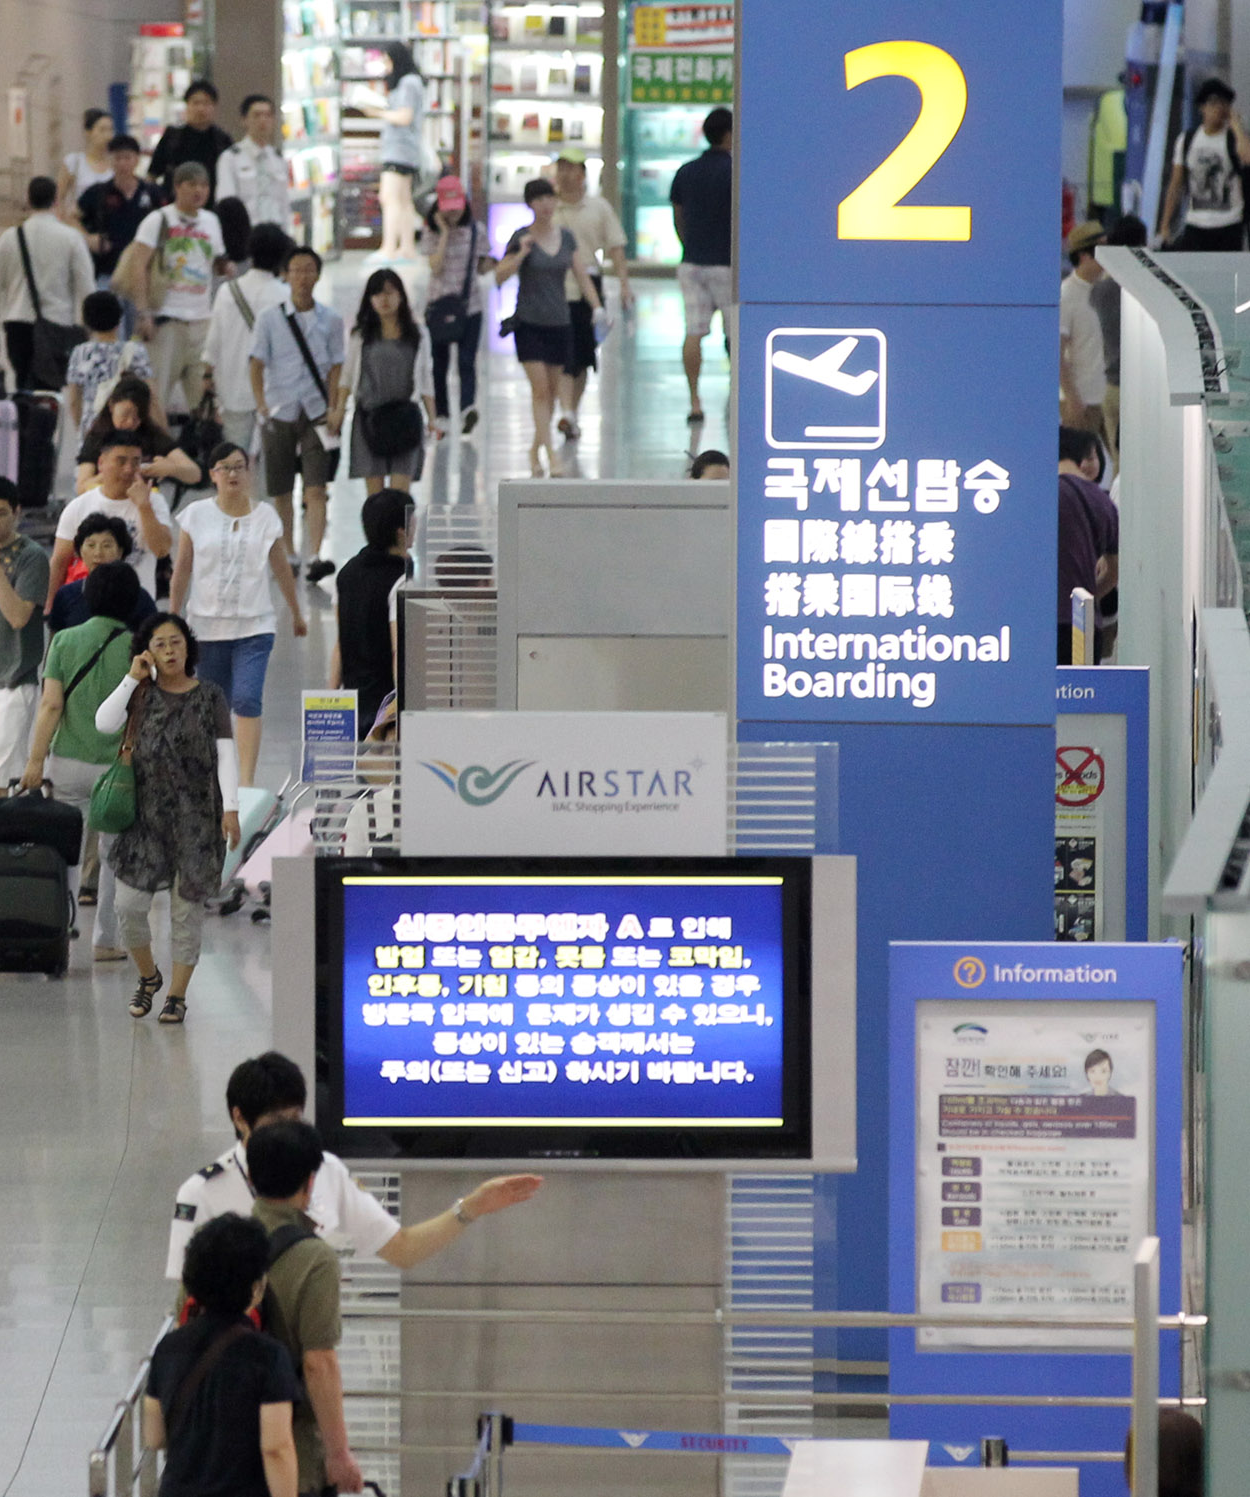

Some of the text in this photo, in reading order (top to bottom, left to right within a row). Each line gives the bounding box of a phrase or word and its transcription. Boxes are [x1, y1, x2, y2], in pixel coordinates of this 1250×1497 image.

[837, 40, 972, 242] 2
[764, 457, 1010, 514] 국제선탑승
[763, 625, 1010, 662] International
[763, 662, 936, 708] Boarding
[537, 770, 693, 797] AIRSTAR
[575, 801, 624, 814] Shopping
[625, 801, 679, 814] Experience
[680, 917, 732, 940] 인해
[375, 945, 425, 969] 발열
[431, 946, 483, 969] 또는
[611, 946, 663, 969] 또는
[994, 963, 1118, 984] Information
[514, 974, 565, 998] 등의
[571, 974, 646, 998] 증상이
[711, 974, 761, 998] 경우
[659, 1003, 687, 1026] 수
[692, 1003, 774, 1026] 있으니,
[432, 1031, 695, 1055] 증상이 있는 승객께서는
[497, 1060, 558, 1084] 신고)
[565, 1060, 639, 1084] 하시기
[647, 1060, 754, 1084] 바랍니다.
[945, 1057, 1068, 1079] 잠깐! 확인해 주세요!
[680, 1436, 749, 1452] SECURITY
